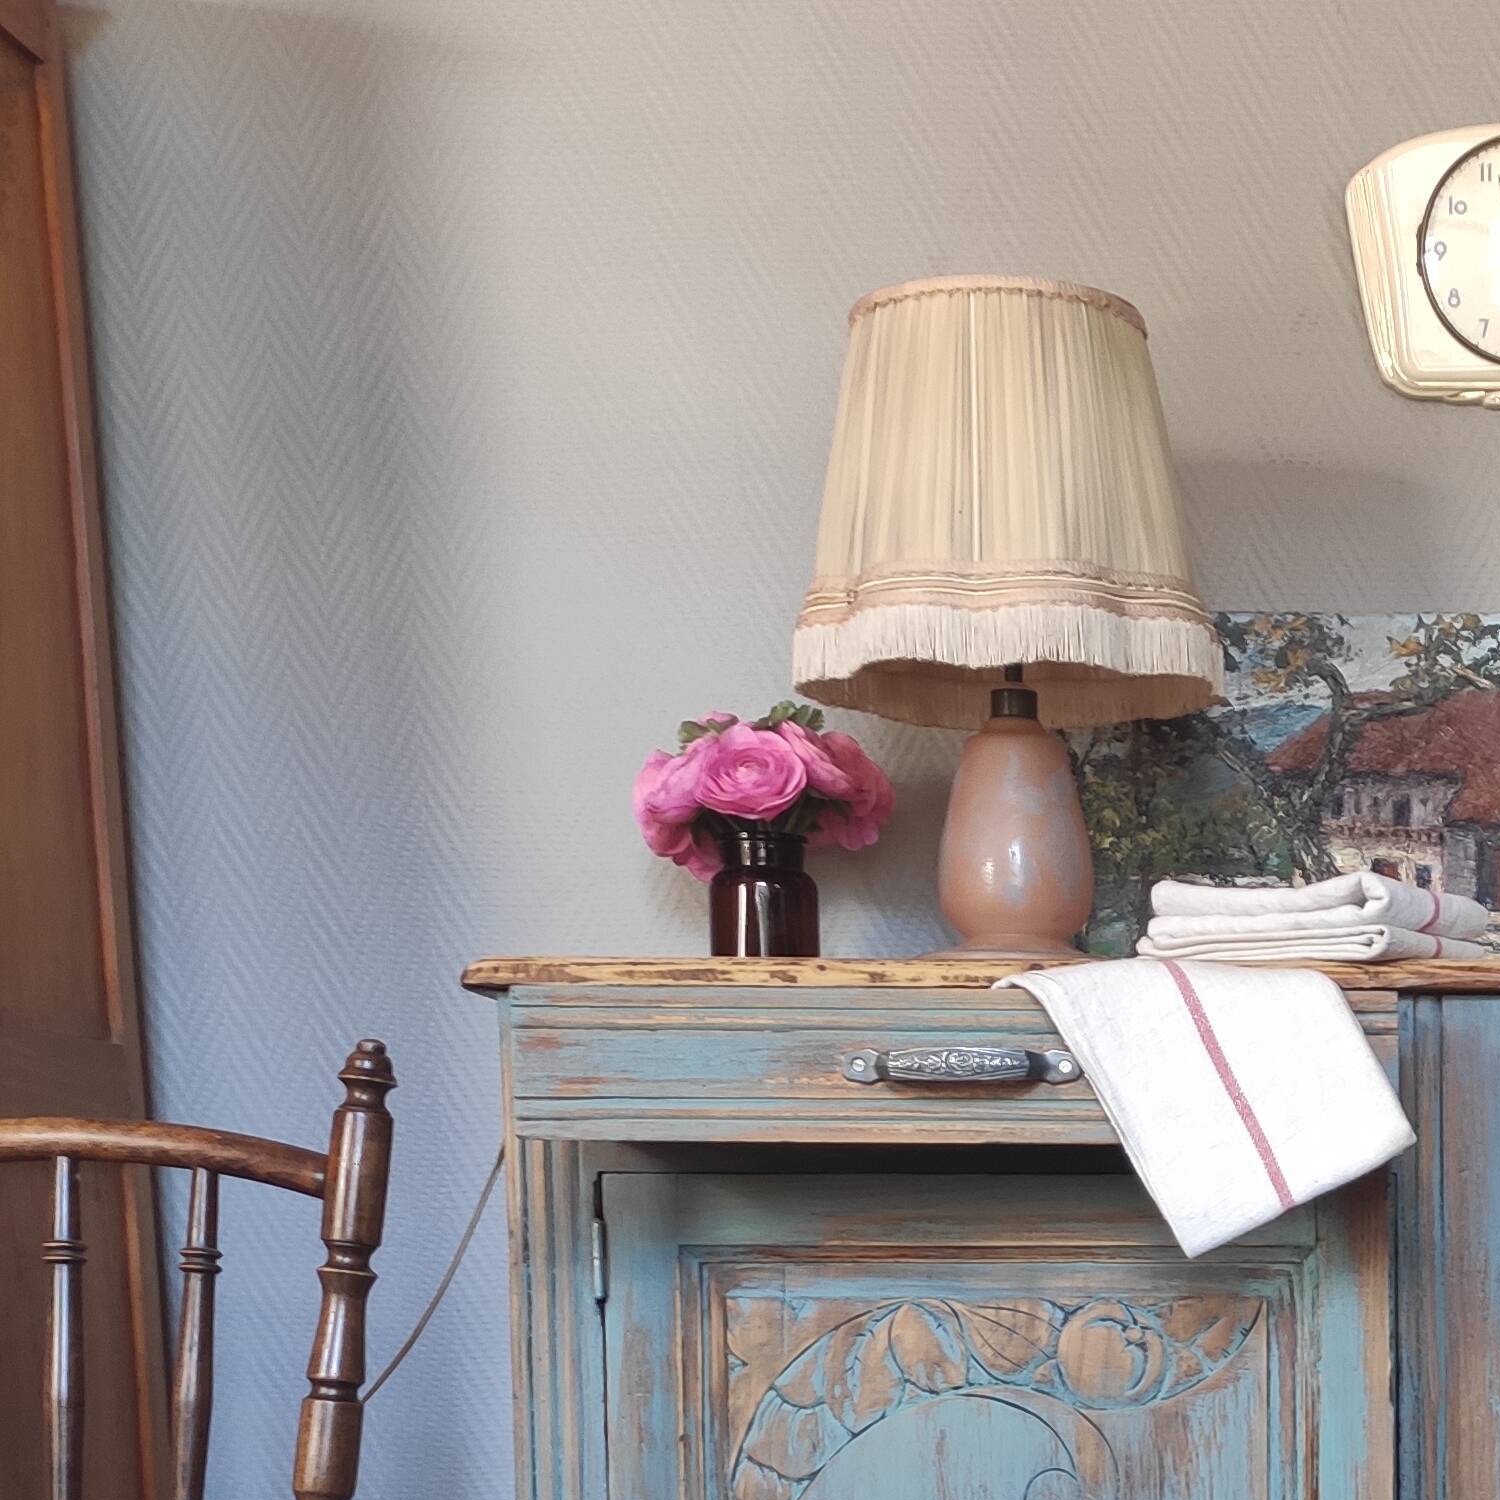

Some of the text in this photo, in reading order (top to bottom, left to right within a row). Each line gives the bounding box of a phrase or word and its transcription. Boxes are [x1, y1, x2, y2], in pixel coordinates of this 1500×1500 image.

[1479, 162, 1492, 182] 11
[1449, 195, 1468, 215] 10
[1433, 241, 1447, 261] 9
[1447, 288, 1461, 308] 8
[1479, 318, 1490, 338] 7
